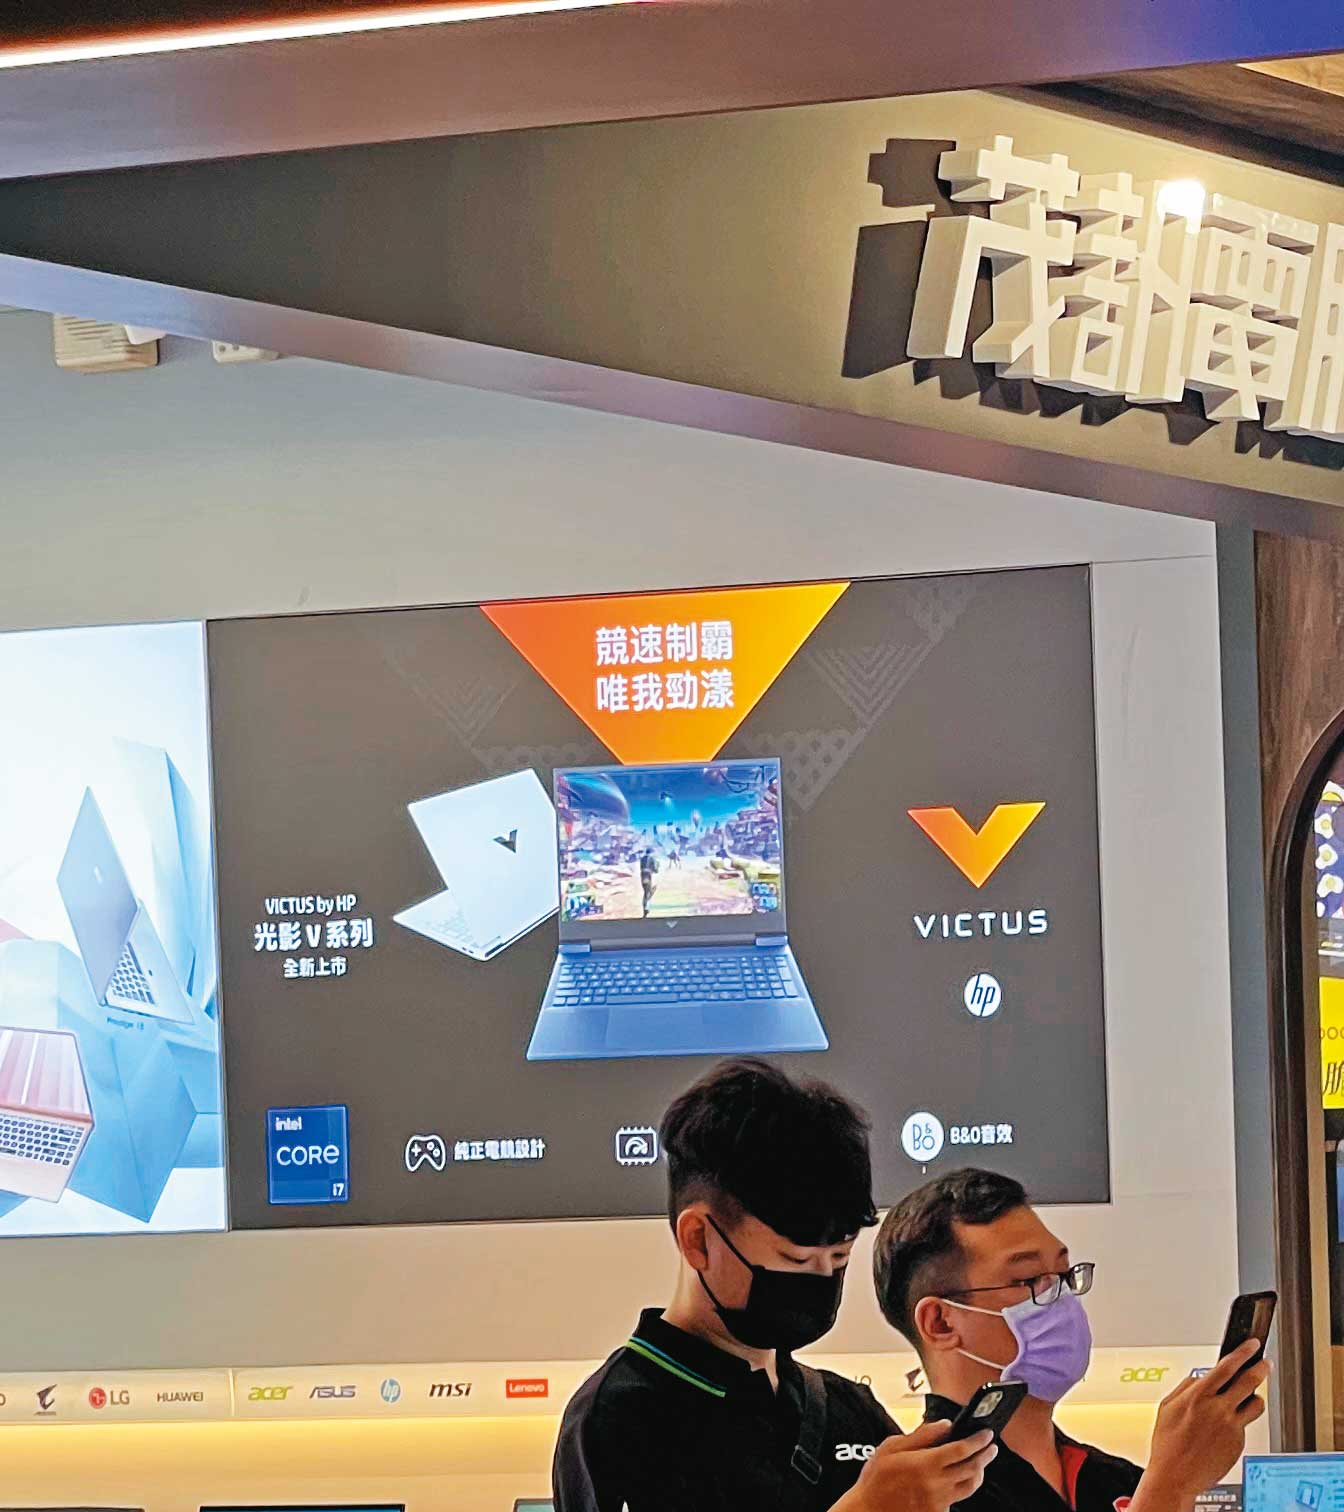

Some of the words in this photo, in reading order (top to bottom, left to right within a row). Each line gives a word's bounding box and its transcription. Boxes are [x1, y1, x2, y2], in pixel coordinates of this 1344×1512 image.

[595, 621, 734, 667] 競速制霸
[595, 669, 735, 713] 唯我勁漾
[265, 896, 315, 915] VICTUS
[316, 895, 334, 916] by
[336, 894, 357, 912] HP
[913, 909, 1048, 938] VICTUS
[254, 921, 302, 951] 光影
[305, 924, 322, 948] V
[326, 918, 374, 949] 系列
[283, 956, 348, 979] 全新上市
[966, 974, 999, 1016] hp
[275, 1116, 303, 1131] intel
[1120, 1366, 1170, 1383] acer
[157, 1391, 204, 1403] HUAWEI
[248, 1384, 294, 1401] acer
[309, 1384, 357, 1399] ASUS
[429, 1382, 473, 1398] msi
[509, 1382, 546, 1394] Lenovo
[835, 1443, 877, 1462] ace
